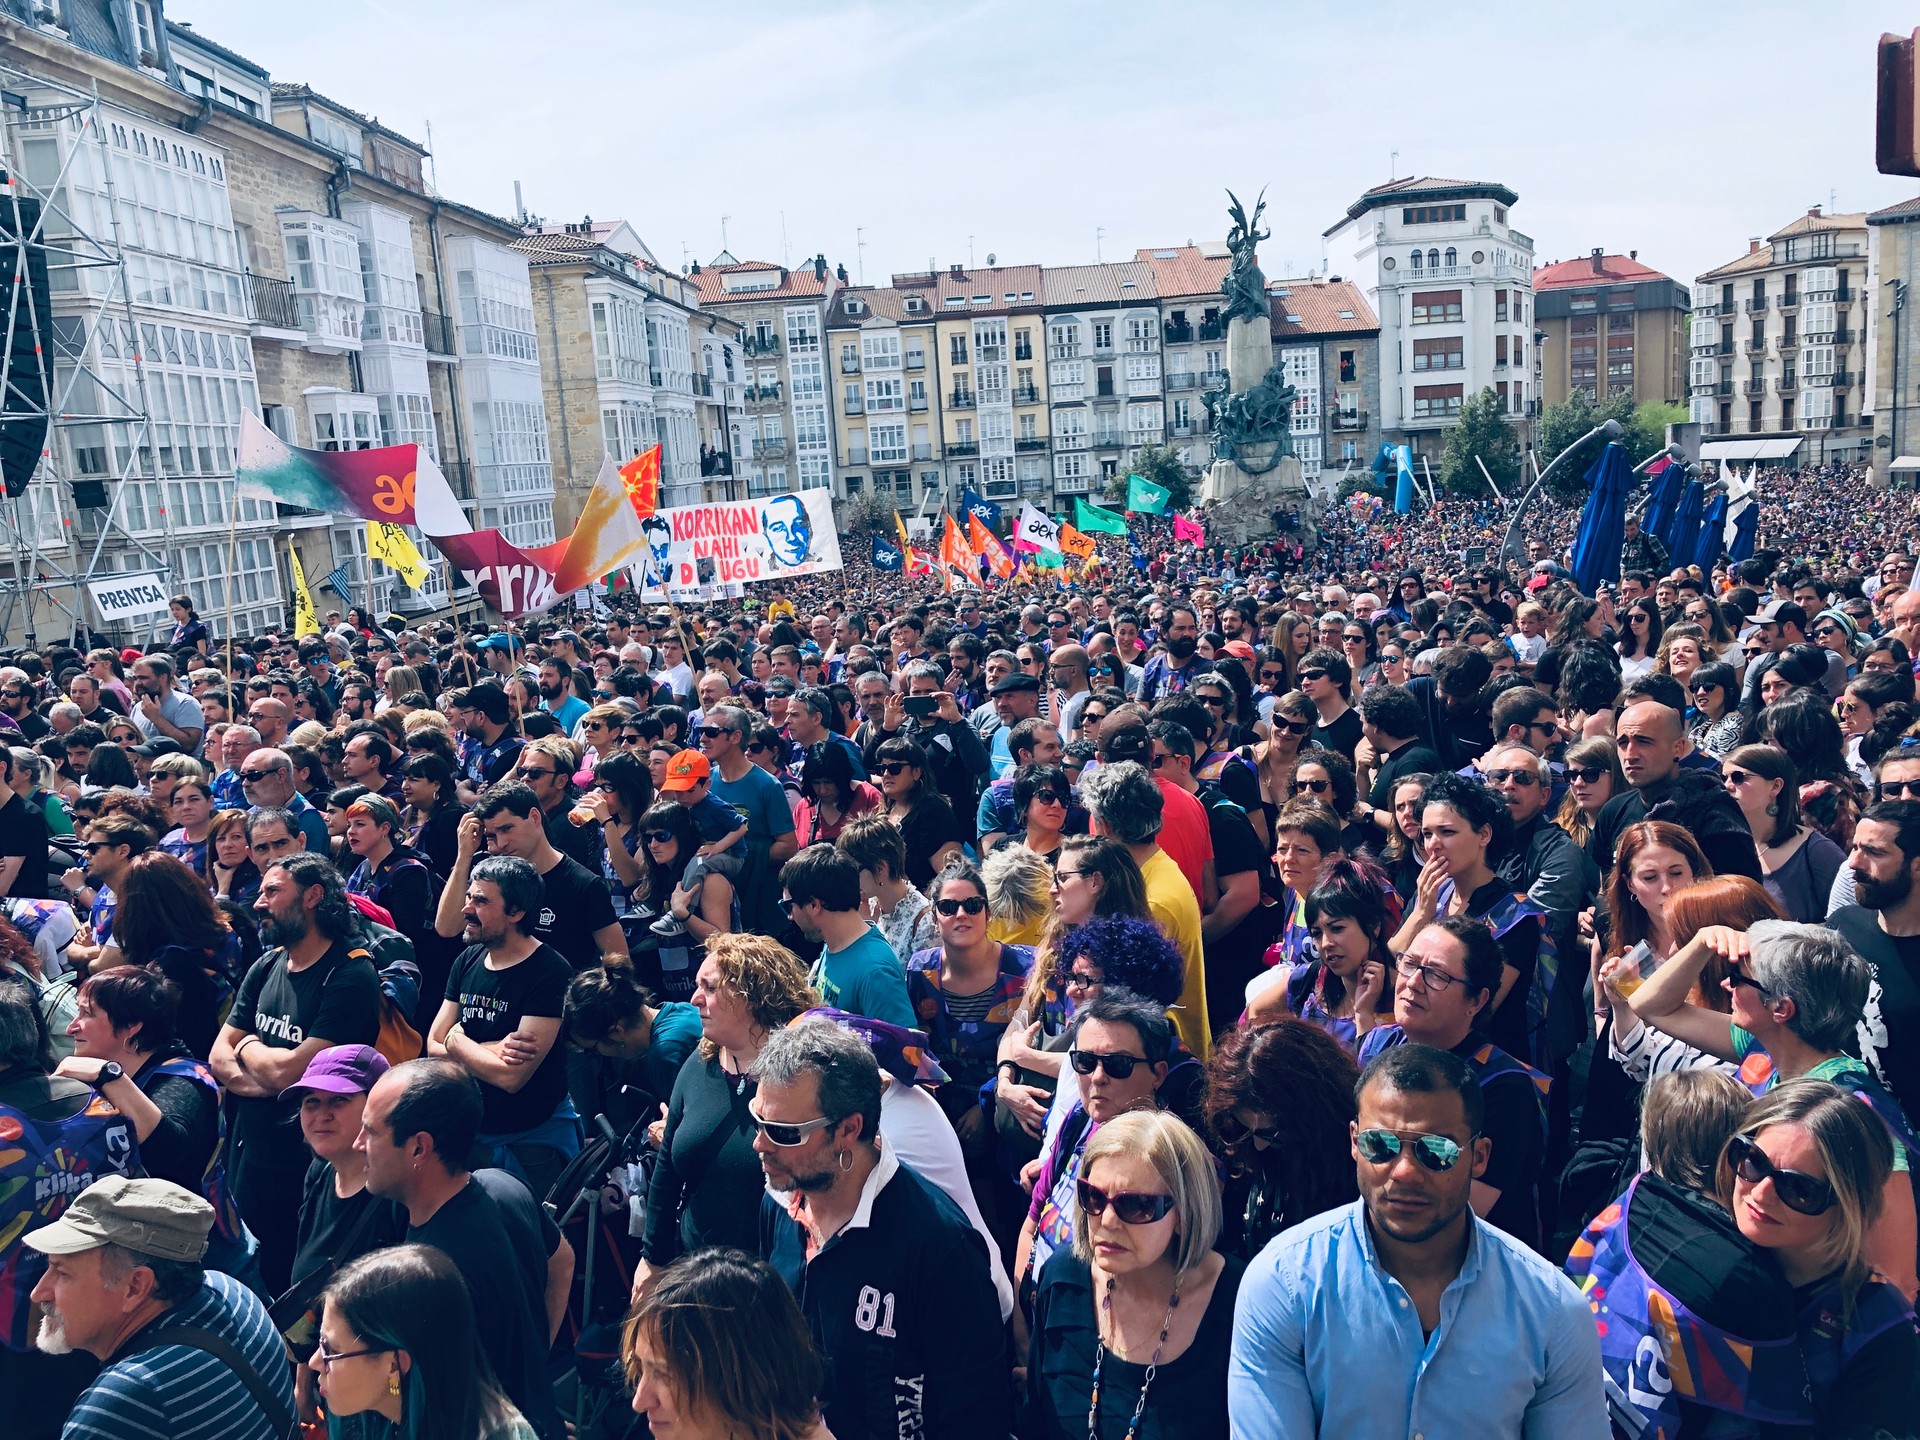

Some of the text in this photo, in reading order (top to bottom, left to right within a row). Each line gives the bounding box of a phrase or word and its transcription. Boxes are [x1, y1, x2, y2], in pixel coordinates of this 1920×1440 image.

[672, 506, 759, 542] KORRIKAN
[1028, 520, 1054, 543] aek
[694, 536, 740, 560] NAHI
[1069, 535, 1090, 551] aek
[780, 562, 815, 576] GALDER
[876, 549, 898, 566] aek
[97, 584, 165, 611] PRENTSA
[462, 1006, 484, 1023] gura
[855, 1285, 897, 1338] 81
